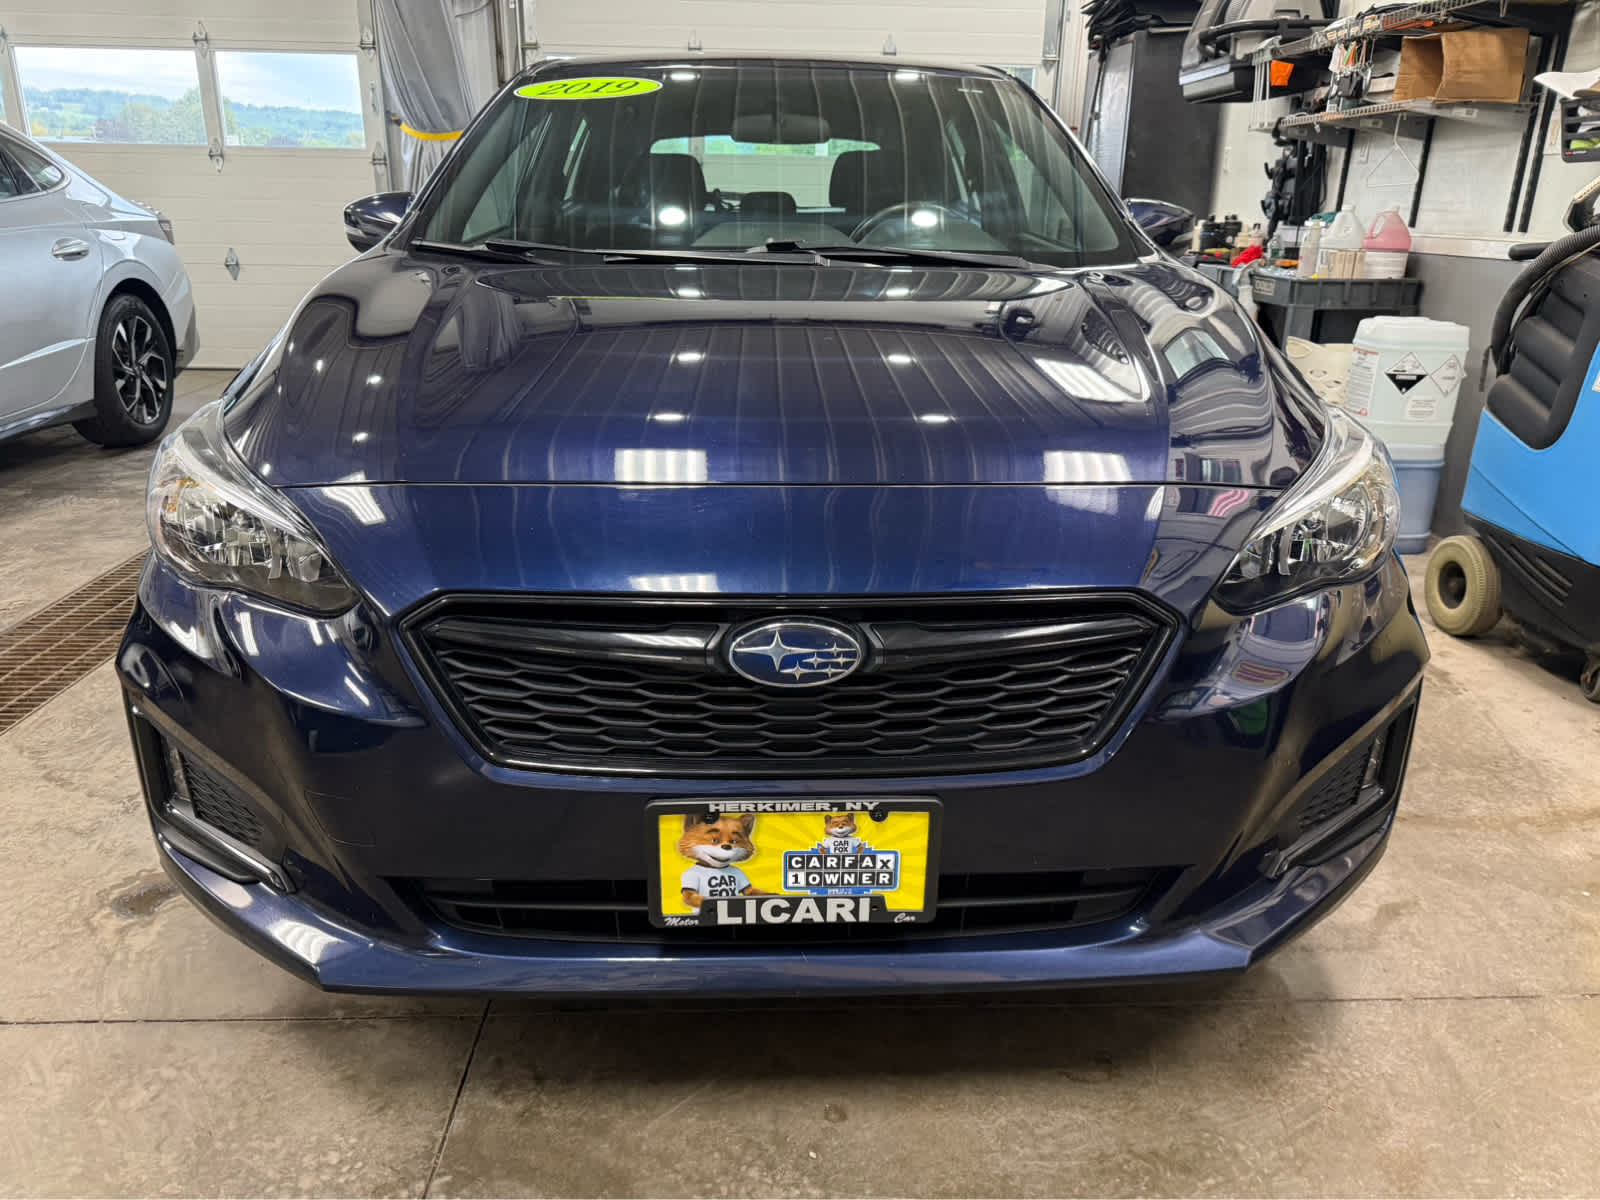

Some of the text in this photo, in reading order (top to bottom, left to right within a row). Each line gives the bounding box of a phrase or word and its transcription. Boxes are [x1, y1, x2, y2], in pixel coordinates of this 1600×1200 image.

[538, 81, 640, 95] 2019
[708, 800, 881, 813] HERKIMER, NY
[791, 856, 892, 870] CARFAX
[707, 875, 737, 888] CAR
[708, 887, 737, 897] FOX
[717, 897, 871, 925] LICARI
[663, 917, 700, 927] Motor
[893, 912, 917, 924] Car
